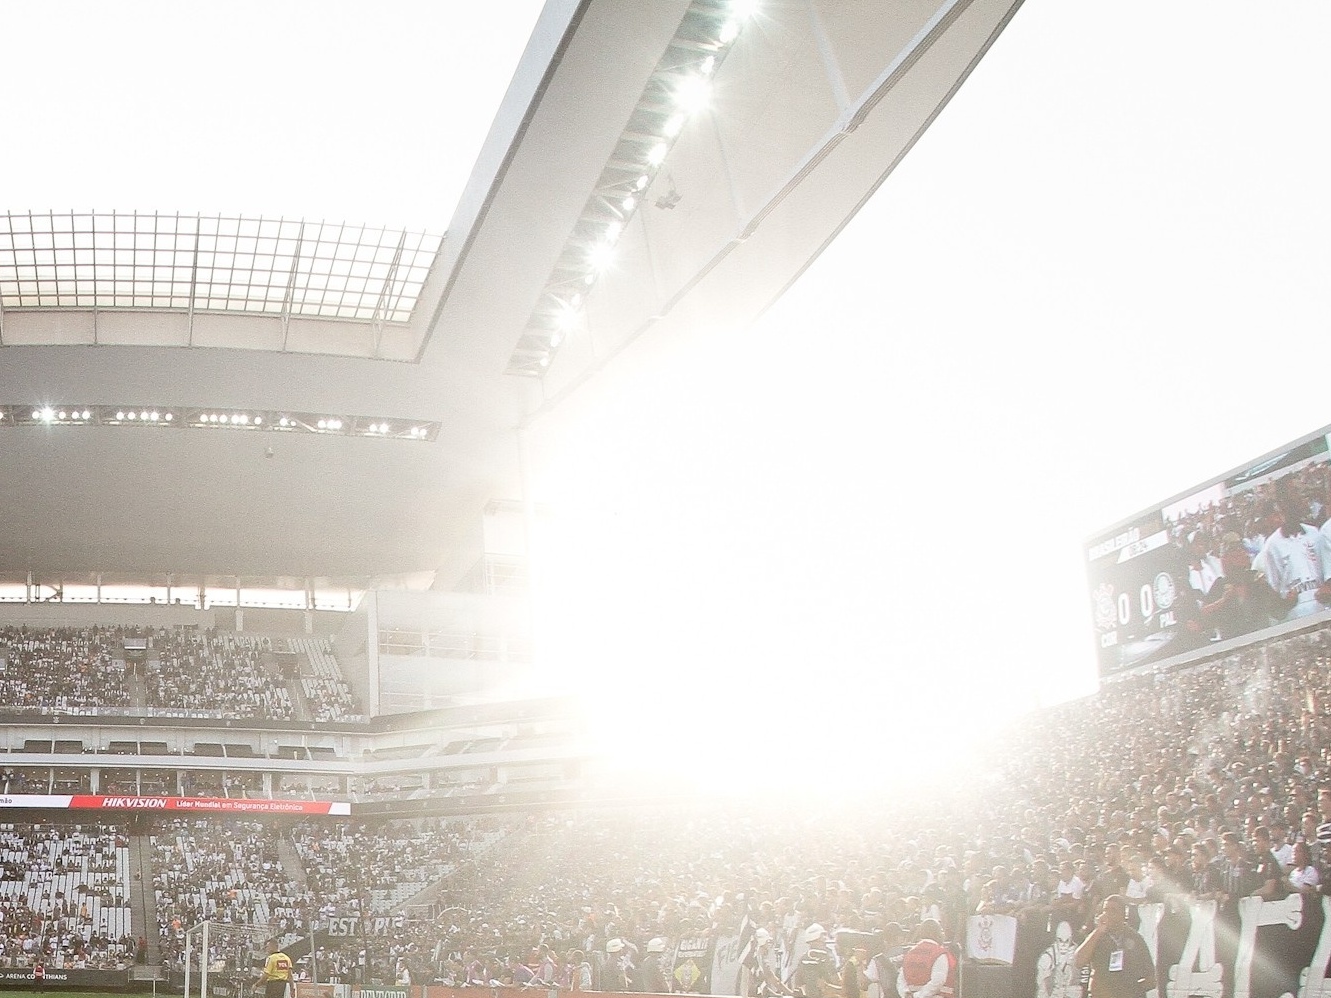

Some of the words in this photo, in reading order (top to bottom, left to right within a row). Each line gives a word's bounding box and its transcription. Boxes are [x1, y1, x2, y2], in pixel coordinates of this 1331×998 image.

[1118, 592, 1130, 625] 0
[1140, 583, 1153, 618] 0
[102, 798, 167, 808] HIKVISION
[176, 799, 193, 807] Líder
[195, 800, 221, 808] Mundial
[233, 801, 269, 811] Segurança
[270, 801, 303, 811] Eletrônica
